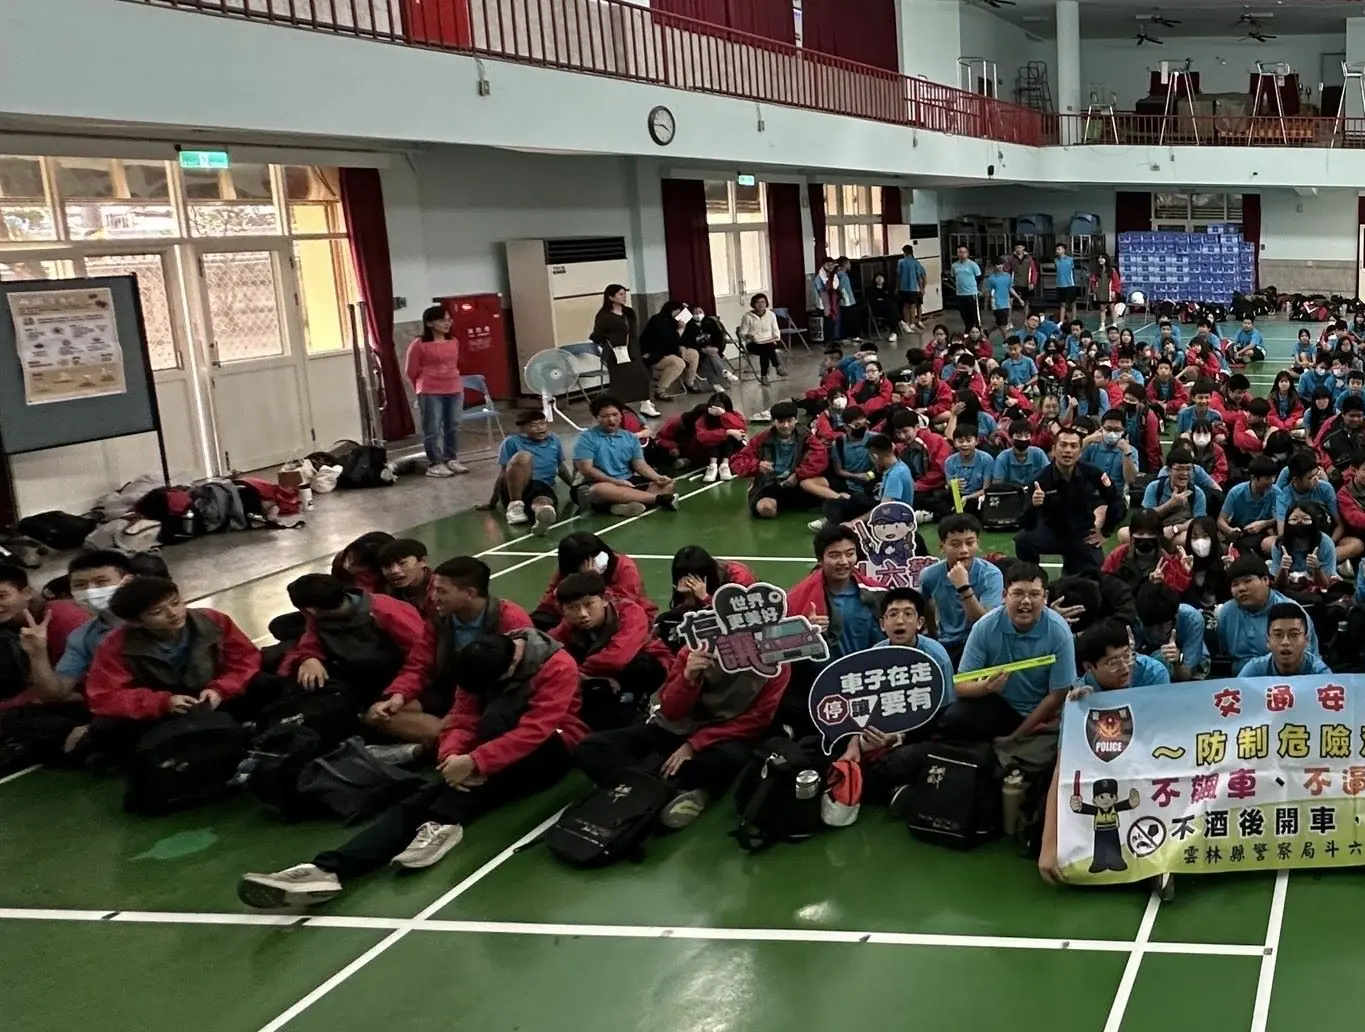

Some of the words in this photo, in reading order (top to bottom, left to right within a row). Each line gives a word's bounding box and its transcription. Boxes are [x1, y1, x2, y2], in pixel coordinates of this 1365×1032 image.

[729, 592, 764, 611] 世界
[840, 662, 933, 694] 車子在走
[1095, 741, 1123, 753] POLICE
